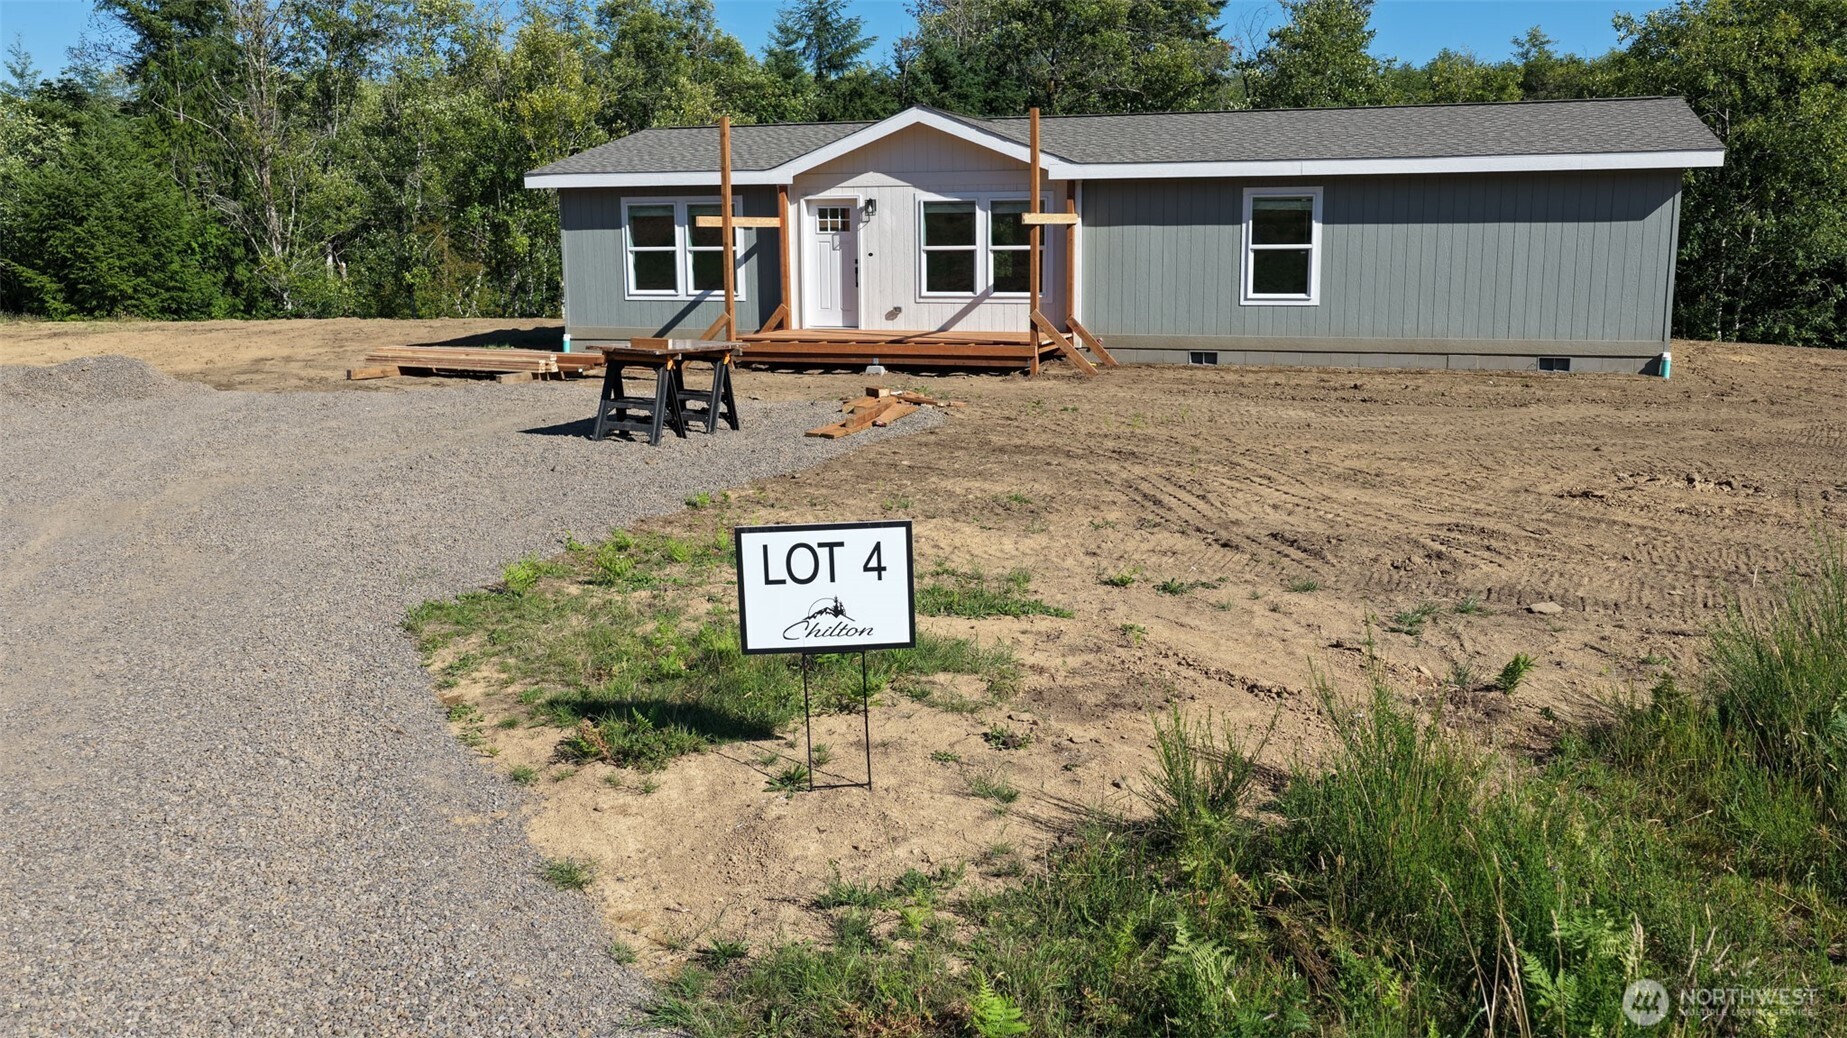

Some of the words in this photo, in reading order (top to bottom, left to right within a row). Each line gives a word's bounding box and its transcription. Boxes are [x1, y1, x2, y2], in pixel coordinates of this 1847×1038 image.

[762, 541, 845, 585] LOT
[862, 541, 887, 581] 4
[782, 620, 874, 641] Chilton
